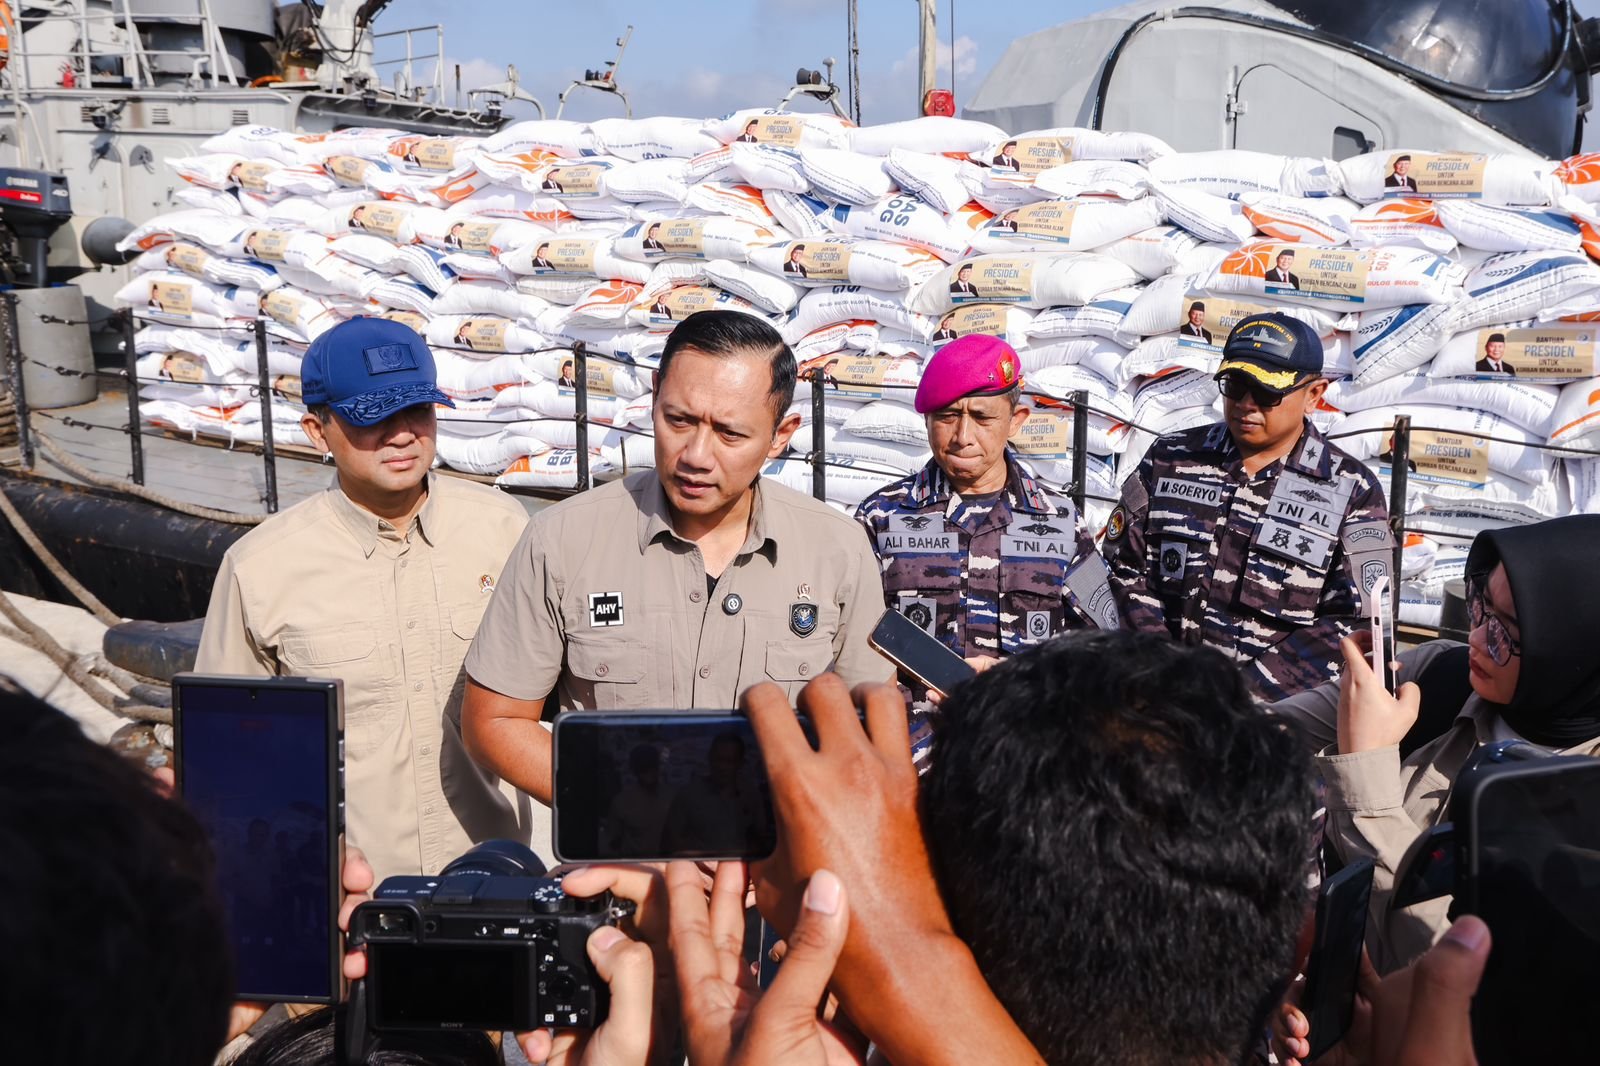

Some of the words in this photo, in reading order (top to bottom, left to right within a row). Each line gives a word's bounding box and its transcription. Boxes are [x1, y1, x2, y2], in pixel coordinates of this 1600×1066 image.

[765, 125, 792, 134] PRESIDEN
[1027, 147, 1063, 158] PRESIDEN
[1426, 161, 1470, 171] PRESIDEN
[1028, 210, 1063, 218] PRESIDEN
[667, 227, 693, 237] PRESIDEN
[557, 248, 585, 257] PRESIDEN
[813, 252, 840, 262] PRESIDEN
[1309, 260, 1354, 272] PRESIDEN
[983, 268, 1020, 279] PRESIDEN
[1320, 271, 1338, 279] UNTUK
[1300, 278, 1319, 286] KORBAN
[677, 296, 706, 304] PRESIDEN
[963, 312, 996, 322] PRESIDEN
[1524, 345, 1575, 358] PRESIDEN
[845, 365, 876, 374] PRESIDEN
[1021, 425, 1055, 435] PRESIDEN
[1436, 436, 1463, 445] BANTUAN
[1425, 445, 1471, 459] PRESIDEN
[1416, 461, 1437, 469] KORBAN
[1438, 463, 1462, 473] BENCANA
[1463, 466, 1478, 475] ALAM
[1160, 481, 1217, 502] M.SOERYO
[1277, 501, 1304, 518] TNI
[1309, 511, 1330, 528] AL
[884, 536, 903, 549] ALI
[908, 537, 950, 548] BAHAR
[1013, 540, 1040, 553] TNI
[1046, 542, 1068, 556] AL
[596, 603, 617, 615] AHY
